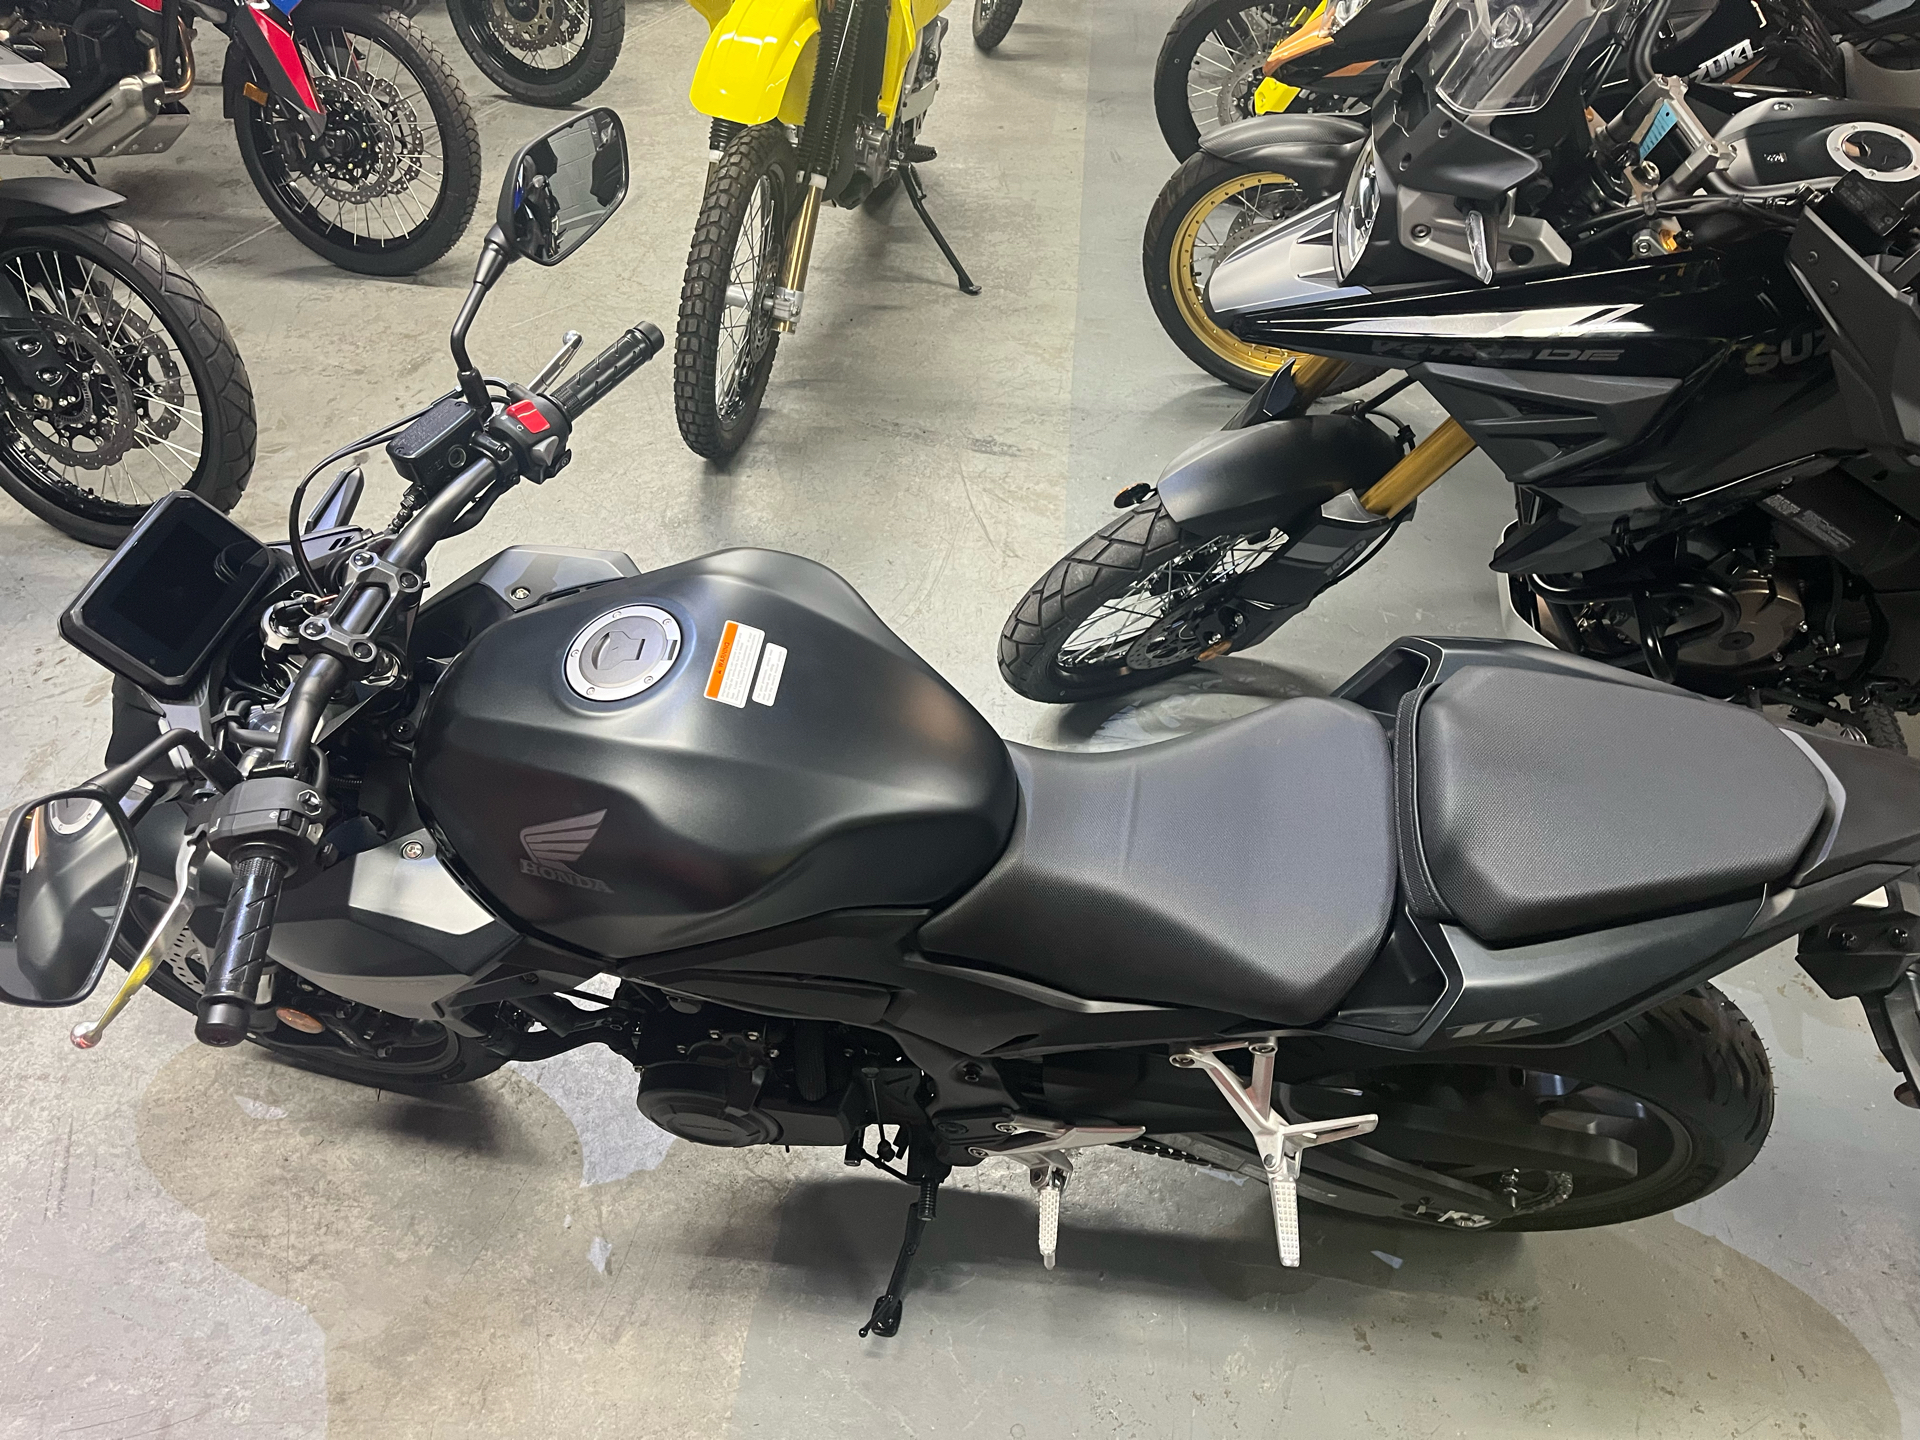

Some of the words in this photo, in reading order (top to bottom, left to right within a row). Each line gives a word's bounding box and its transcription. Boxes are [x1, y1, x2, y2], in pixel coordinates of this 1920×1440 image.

[1682, 38, 1754, 83] ZUKI
[1535, 349, 1625, 361] DE
[1744, 329, 1831, 375] SUZ
[1324, 539, 1367, 576] 1050
[718, 642, 730, 668] WARNING
[520, 858, 615, 894] HONDA
